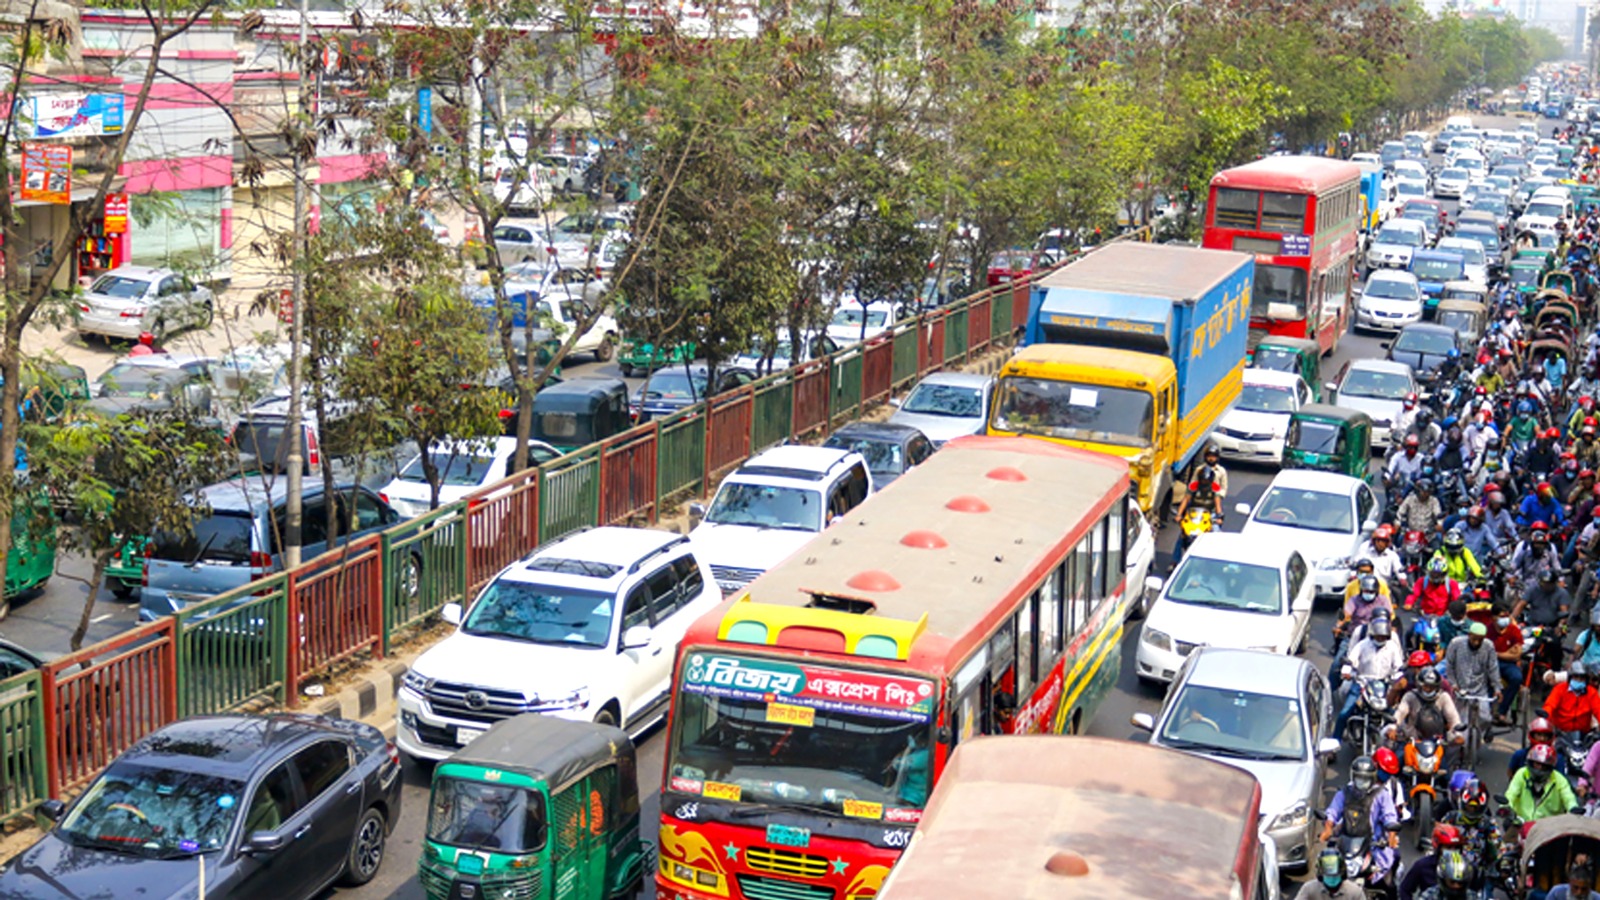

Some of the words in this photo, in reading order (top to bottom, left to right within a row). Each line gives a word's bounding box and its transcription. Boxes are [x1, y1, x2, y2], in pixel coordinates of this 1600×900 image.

[703, 657, 802, 694] বিজয়
[807, 678, 880, 701] এক্সপ্রেস
[885, 682, 916, 705] লিঃ
